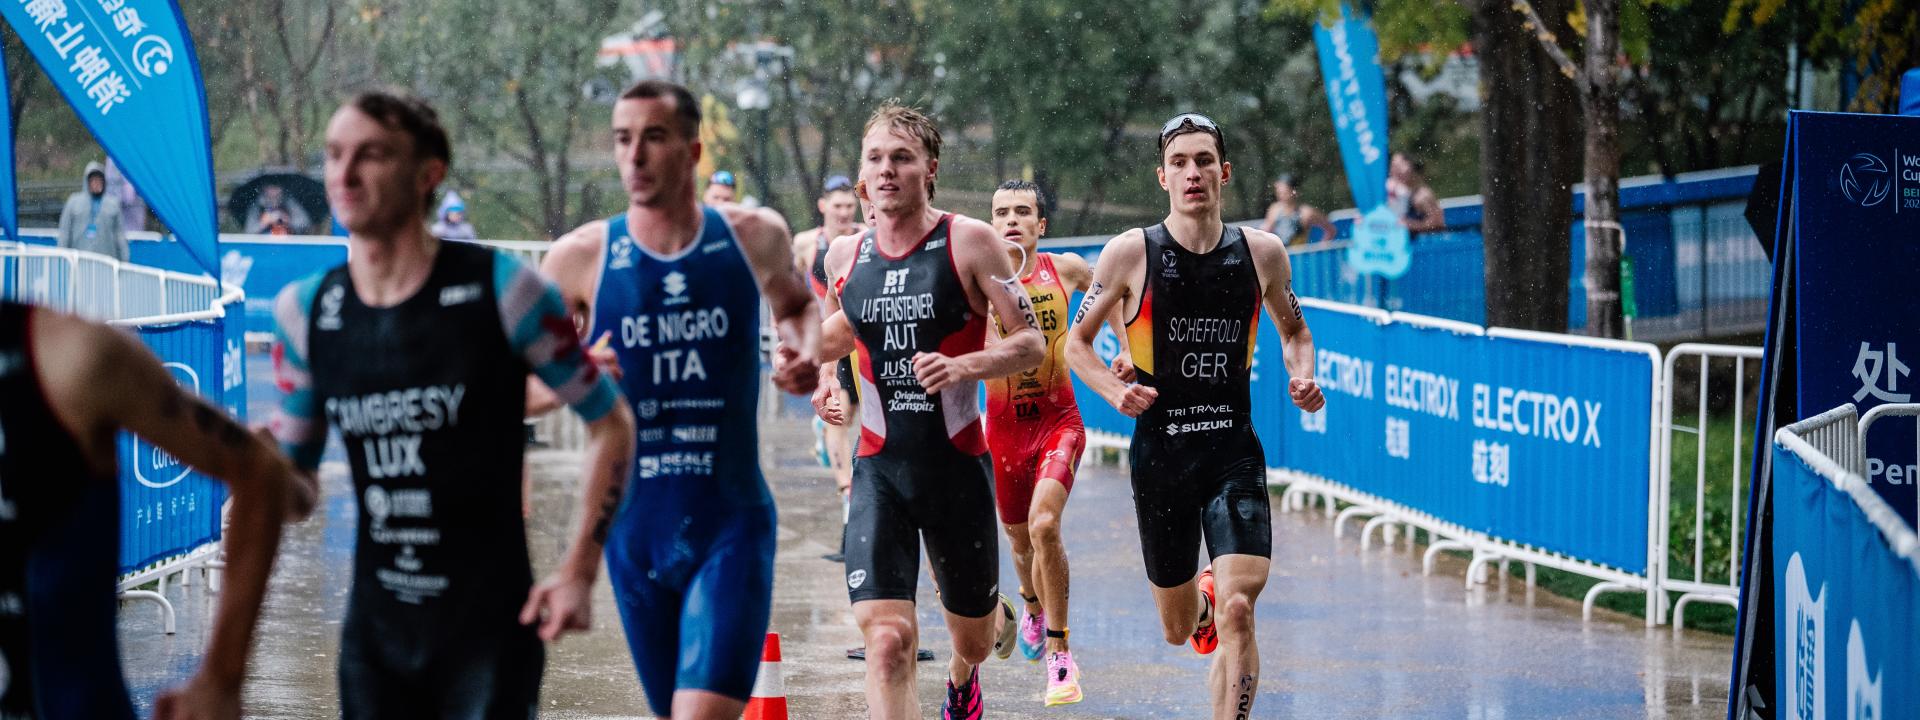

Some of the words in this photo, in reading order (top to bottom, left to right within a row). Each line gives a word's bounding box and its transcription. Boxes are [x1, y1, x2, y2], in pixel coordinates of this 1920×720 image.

[884, 268, 910, 287] BT
[861, 292, 936, 323] LUFTENSTEINER
[1031, 293, 1054, 304] ZUKI
[621, 315, 651, 349] DE
[657, 306, 729, 344] NIGRO
[883, 322, 918, 351] AUT
[1168, 316, 1241, 343] SCHEFFOLD
[653, 348, 707, 386] ITA
[1181, 352, 1228, 378] GER
[1851, 341, 1912, 404] 处
[1167, 408, 1186, 417] TRI
[1189, 404, 1233, 415] TRAVEL
[1182, 419, 1233, 433] SUZUKI
[363, 435, 427, 478] LUX
